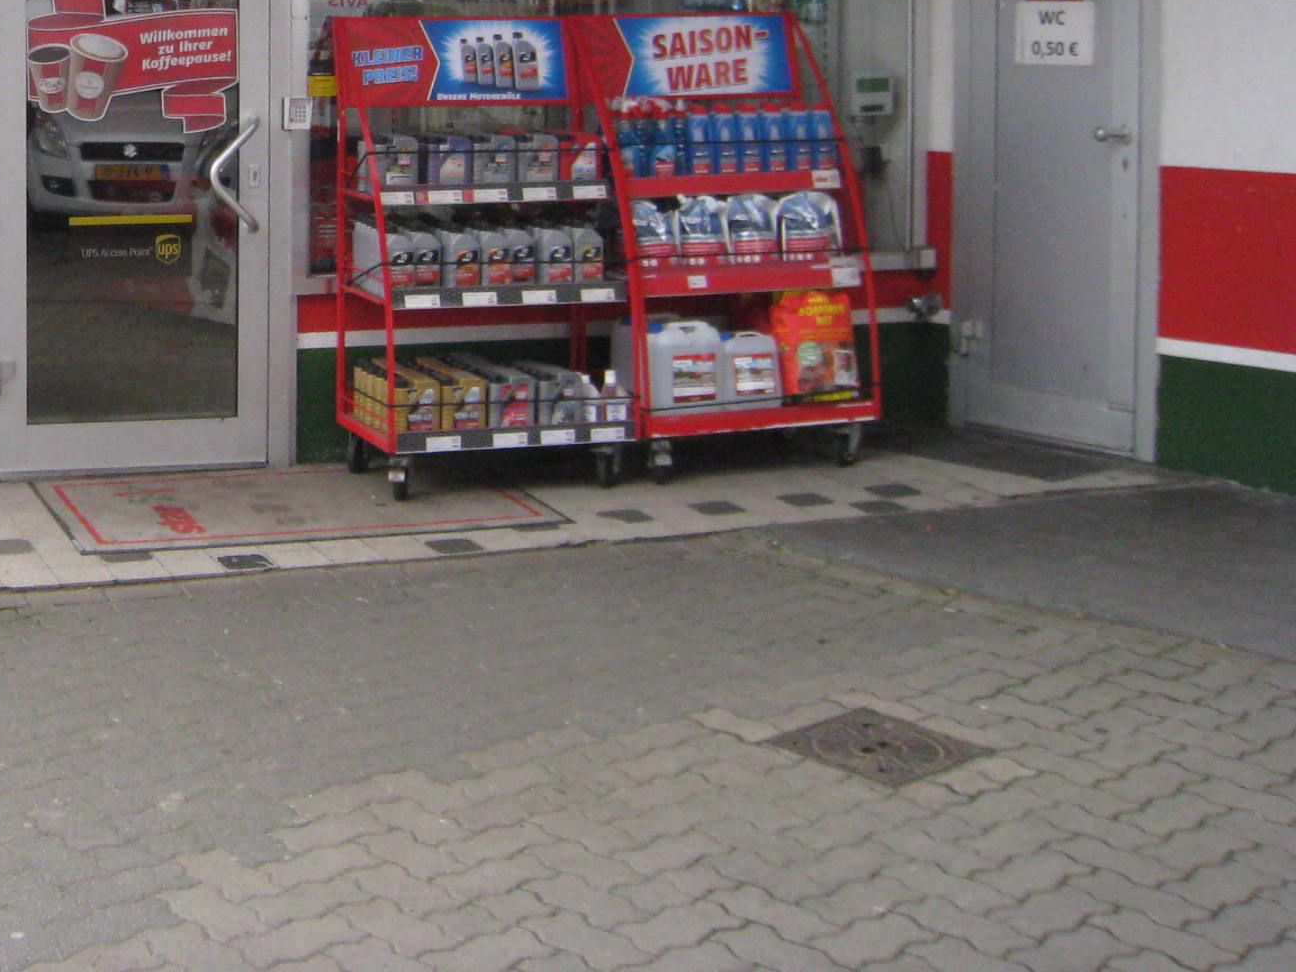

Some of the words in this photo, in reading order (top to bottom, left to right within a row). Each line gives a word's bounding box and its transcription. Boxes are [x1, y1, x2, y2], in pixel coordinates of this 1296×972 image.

[1039, 11, 1066, 25] WC
[139, 27, 228, 45] Willkommen
[652, 24, 770, 61] SAISON-
[158, 45, 174, 56] zu
[179, 40, 213, 54] Ihrer
[352, 45, 423, 68] KLEINER
[1032, 41, 1064, 58] 0,50
[1069, 42, 1079, 56] €
[142, 51, 232, 71] Kaffeepause!
[362, 65, 419, 86] PREIS!
[666, 58, 749, 92] WARE
[81, 248, 100, 258] UPS
[158, 243, 179, 259] ups
